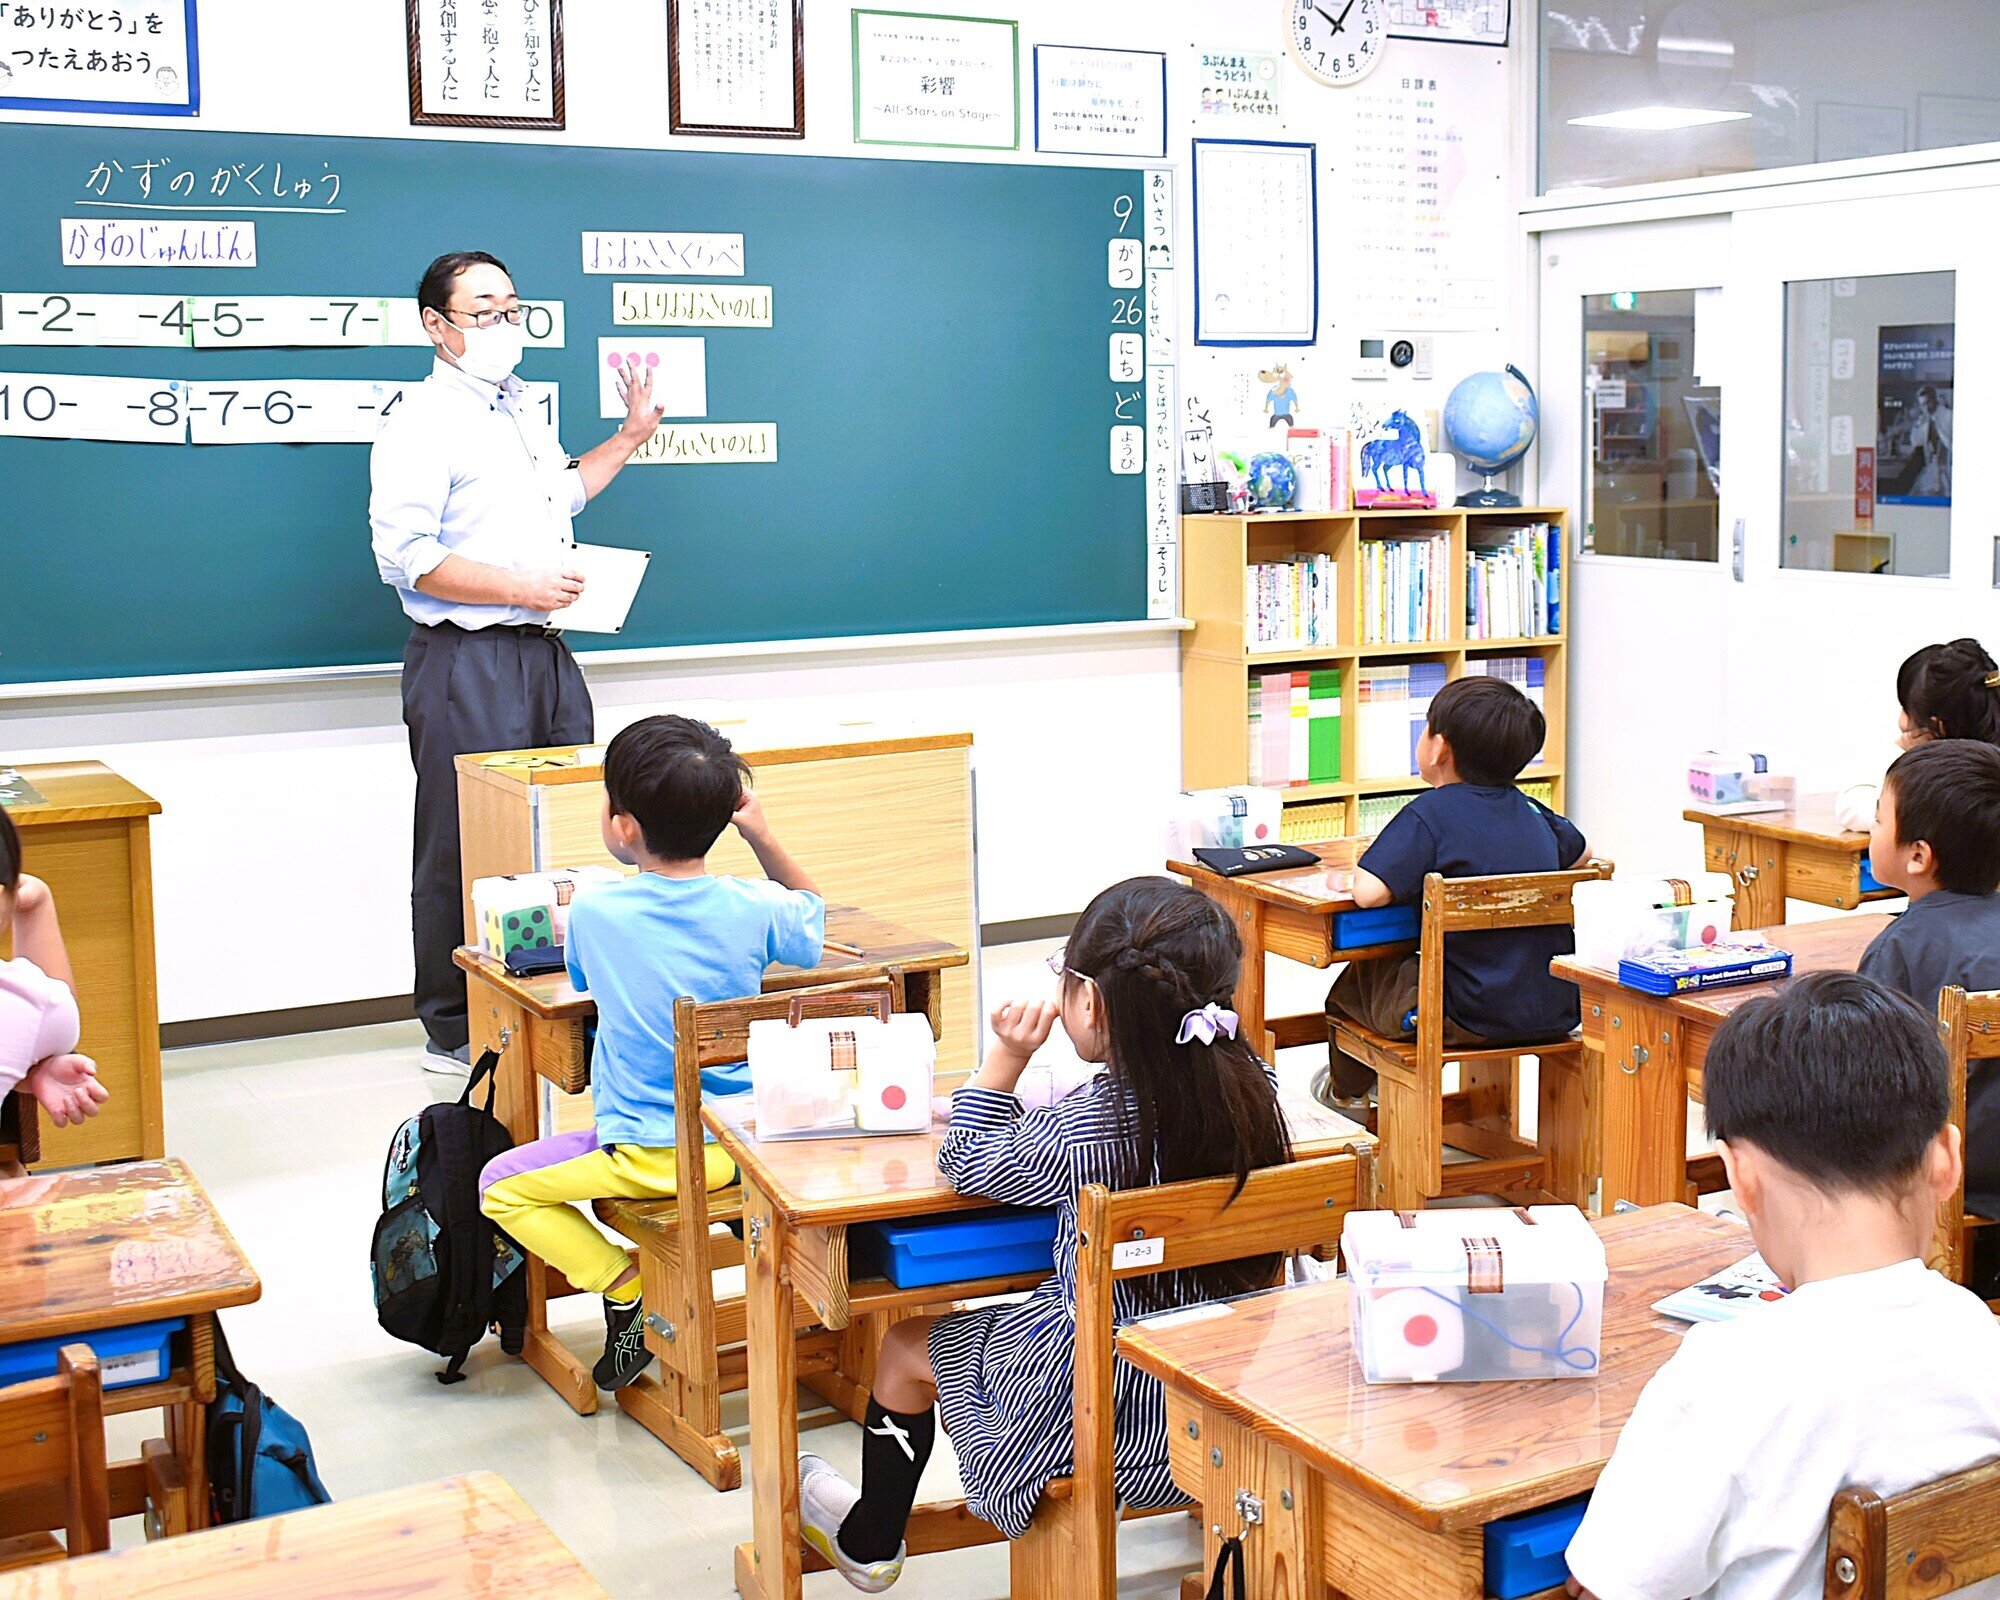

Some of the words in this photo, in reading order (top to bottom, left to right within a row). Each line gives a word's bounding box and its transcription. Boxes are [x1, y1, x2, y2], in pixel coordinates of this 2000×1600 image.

[0, 3, 163, 34] 「ありがとう」を
[1361, 0, 1368, 14] 2
[1299, 16, 1306, 30] 9
[1366, 20, 1373, 34] 3
[1304, 36, 1311, 50] 8
[1360, 41, 1369, 54] 4
[12, 47, 151, 73] つたえあおう
[1318, 52, 1325, 66] 7
[1333, 58, 1341, 72] 6
[1348, 54, 1355, 68] 5
[920, 75, 956, 96] 彩響
[941, 109, 955, 118] on
[1112, 194, 1134, 233] 9
[1152, 174, 1166, 237] あいさつ
[69, 223, 253, 261] かずのじゅんばん
[1118, 244, 1134, 281] がつ
[1110, 294, 1143, 325] 26
[1119, 339, 1134, 377] にち
[538, 393, 552, 425] 1
[1114, 390, 1142, 420] ど
[1121, 430, 1136, 469] ようび
[1157, 546, 1168, 593] そうじ
[1125, 1246, 1152, 1258] 1-2-3
